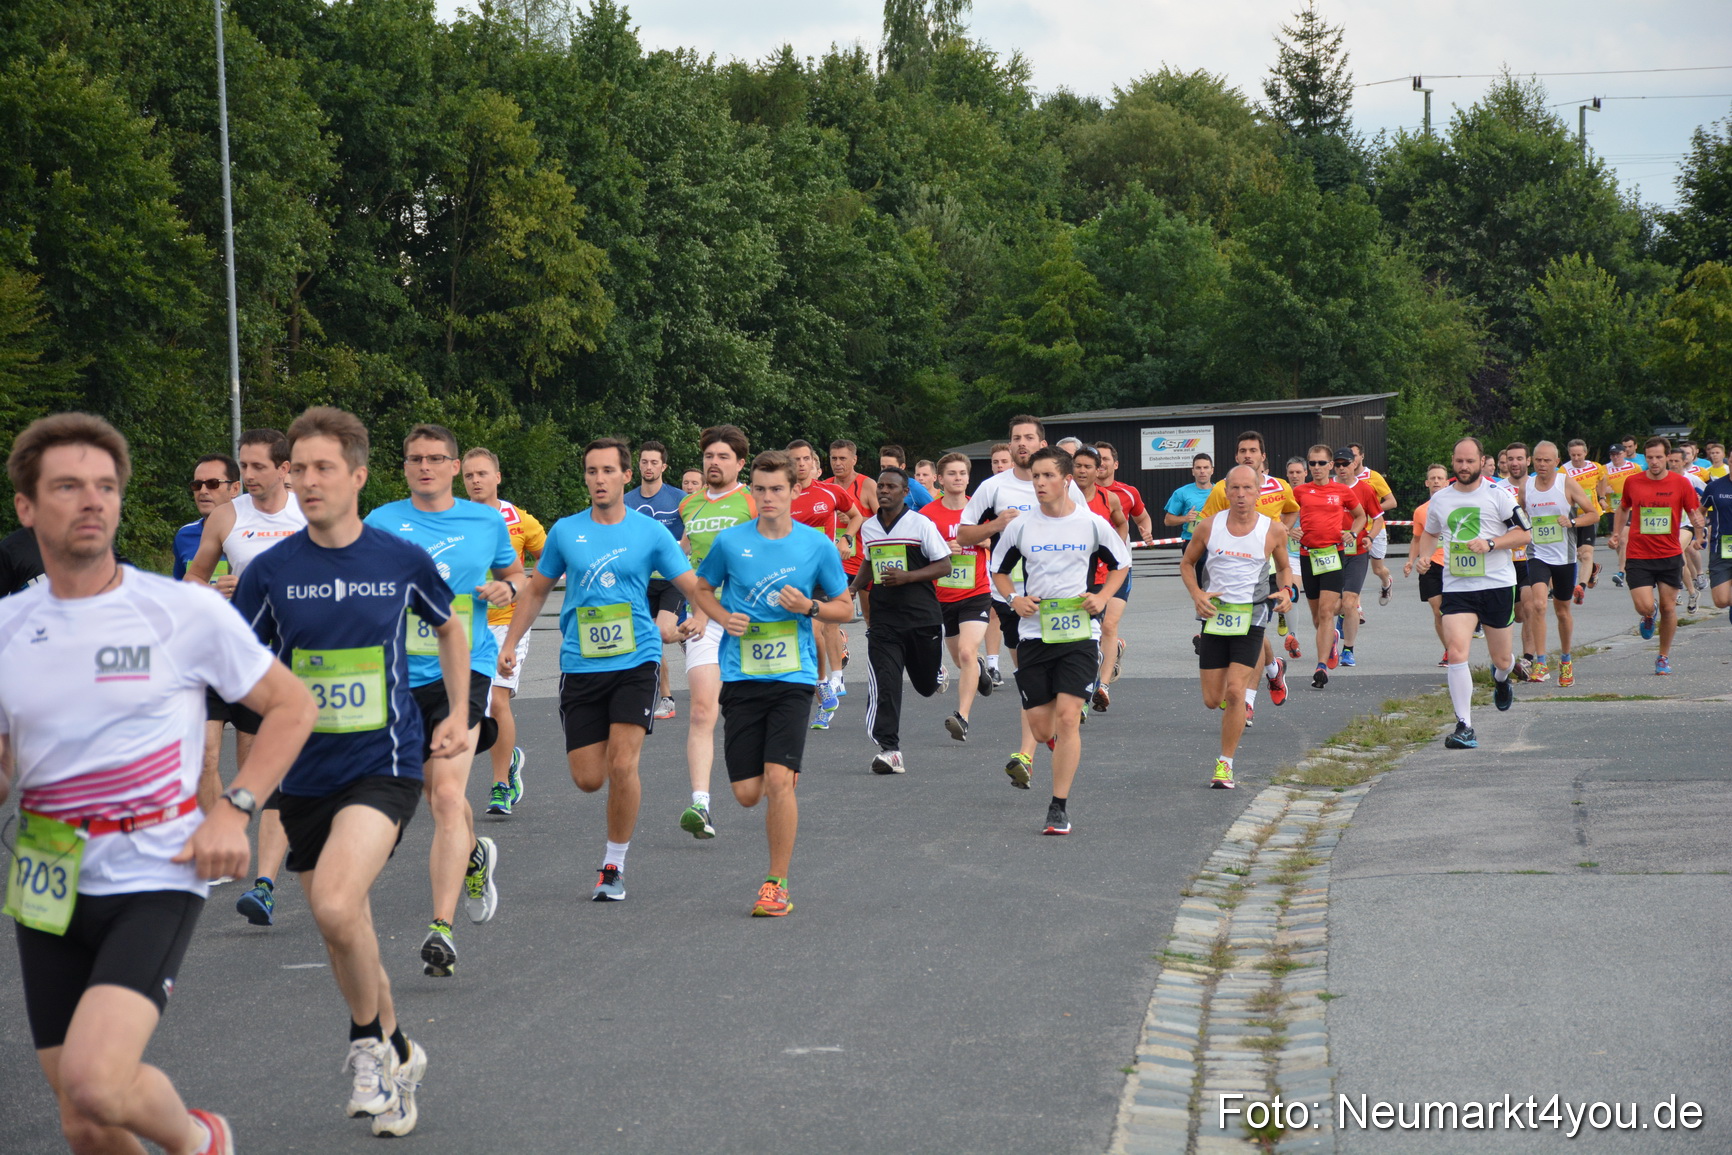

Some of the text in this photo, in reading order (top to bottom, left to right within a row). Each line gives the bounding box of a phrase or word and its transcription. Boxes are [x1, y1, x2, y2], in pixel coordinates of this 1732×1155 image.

[1158, 439, 1184, 449] AST
[1643, 517, 1669, 527] 1479
[447, 535, 465, 543] Bau
[1538, 526, 1556, 537] 591
[1031, 544, 1086, 553] DELPHI
[580, 547, 627, 587] Team Schick Bau
[1314, 555, 1336, 567] 1587
[1455, 555, 1477, 567] 100
[755, 571, 780, 588] Schick
[780, 565, 797, 575] Bau
[945, 568, 967, 579] 51
[287, 582, 397, 600] EURO POLES
[1051, 615, 1081, 631] 285
[1216, 613, 1241, 628] 581
[589, 624, 623, 643] 802
[95, 646, 150, 670] OM
[752, 642, 787, 660] 822
[311, 682, 366, 709] 350
